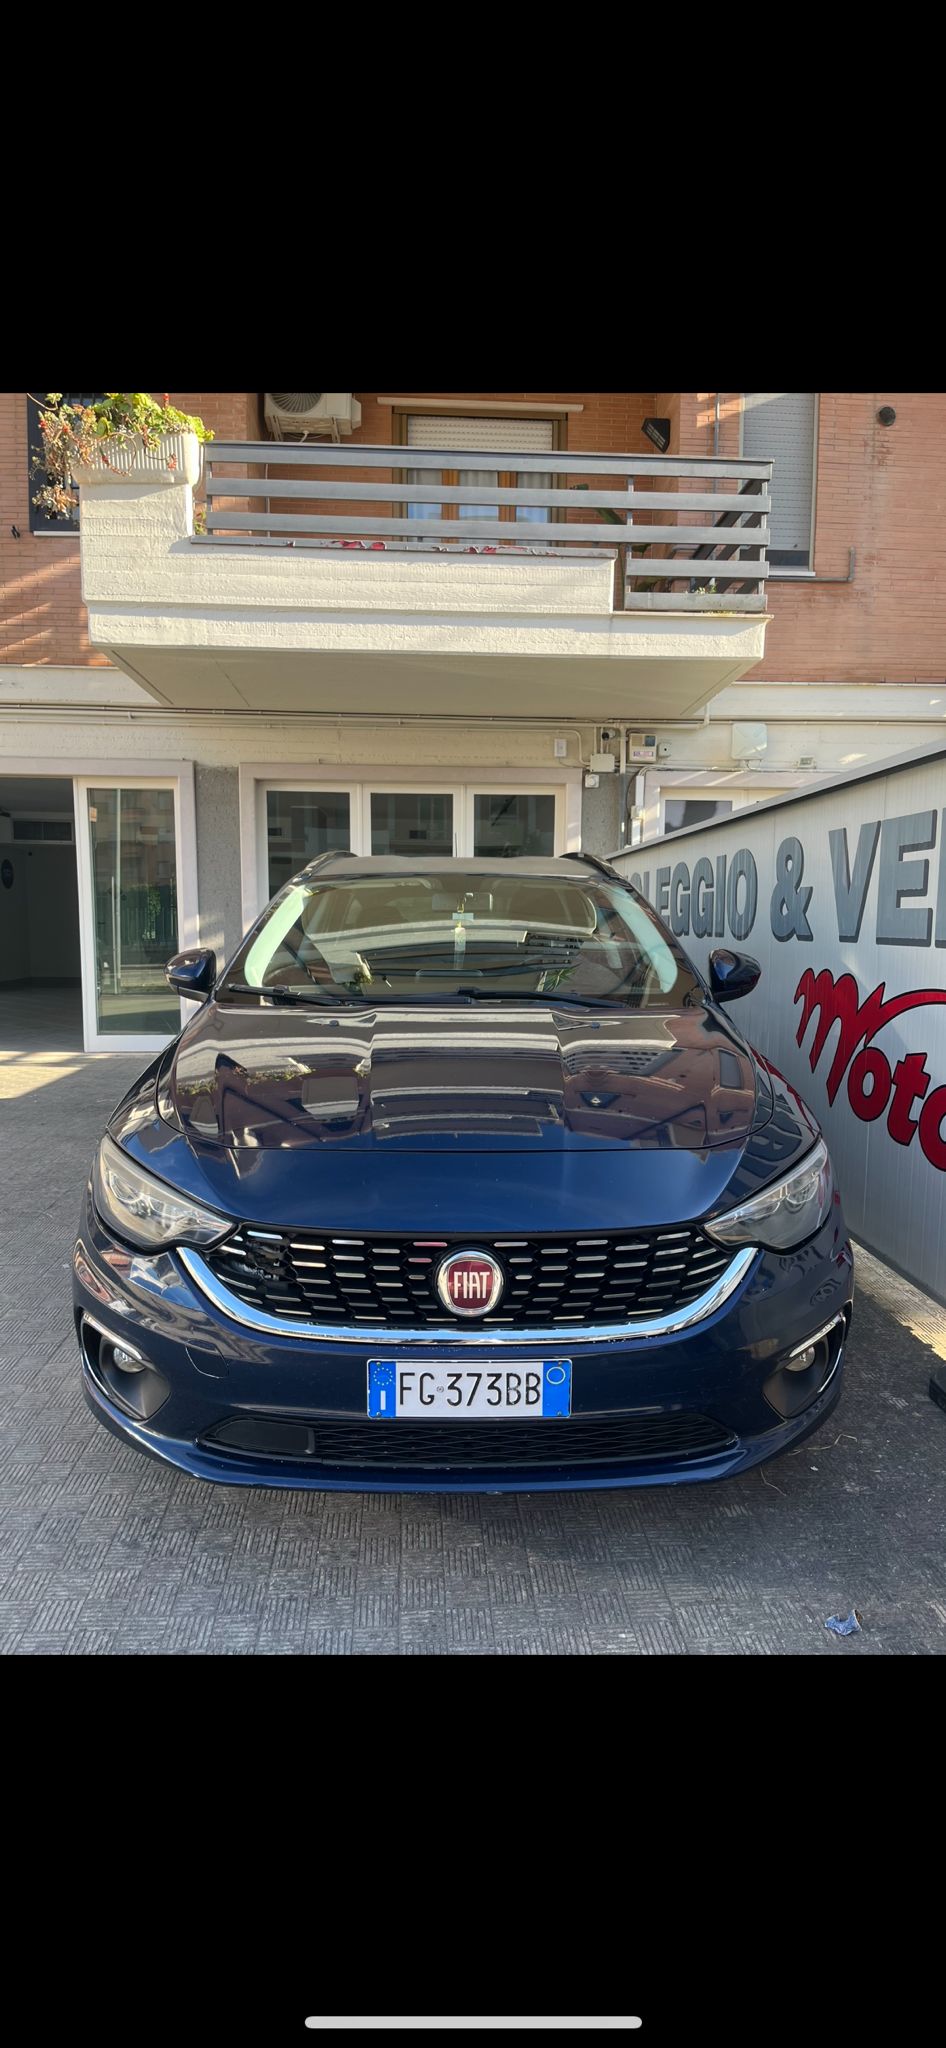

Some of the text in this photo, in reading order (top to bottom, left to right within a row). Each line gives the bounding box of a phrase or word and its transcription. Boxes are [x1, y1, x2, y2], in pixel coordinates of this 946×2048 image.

[770, 836, 813, 942] &
[828, 809, 946, 948] VE
[453, 1271, 490, 1299] FIAT
